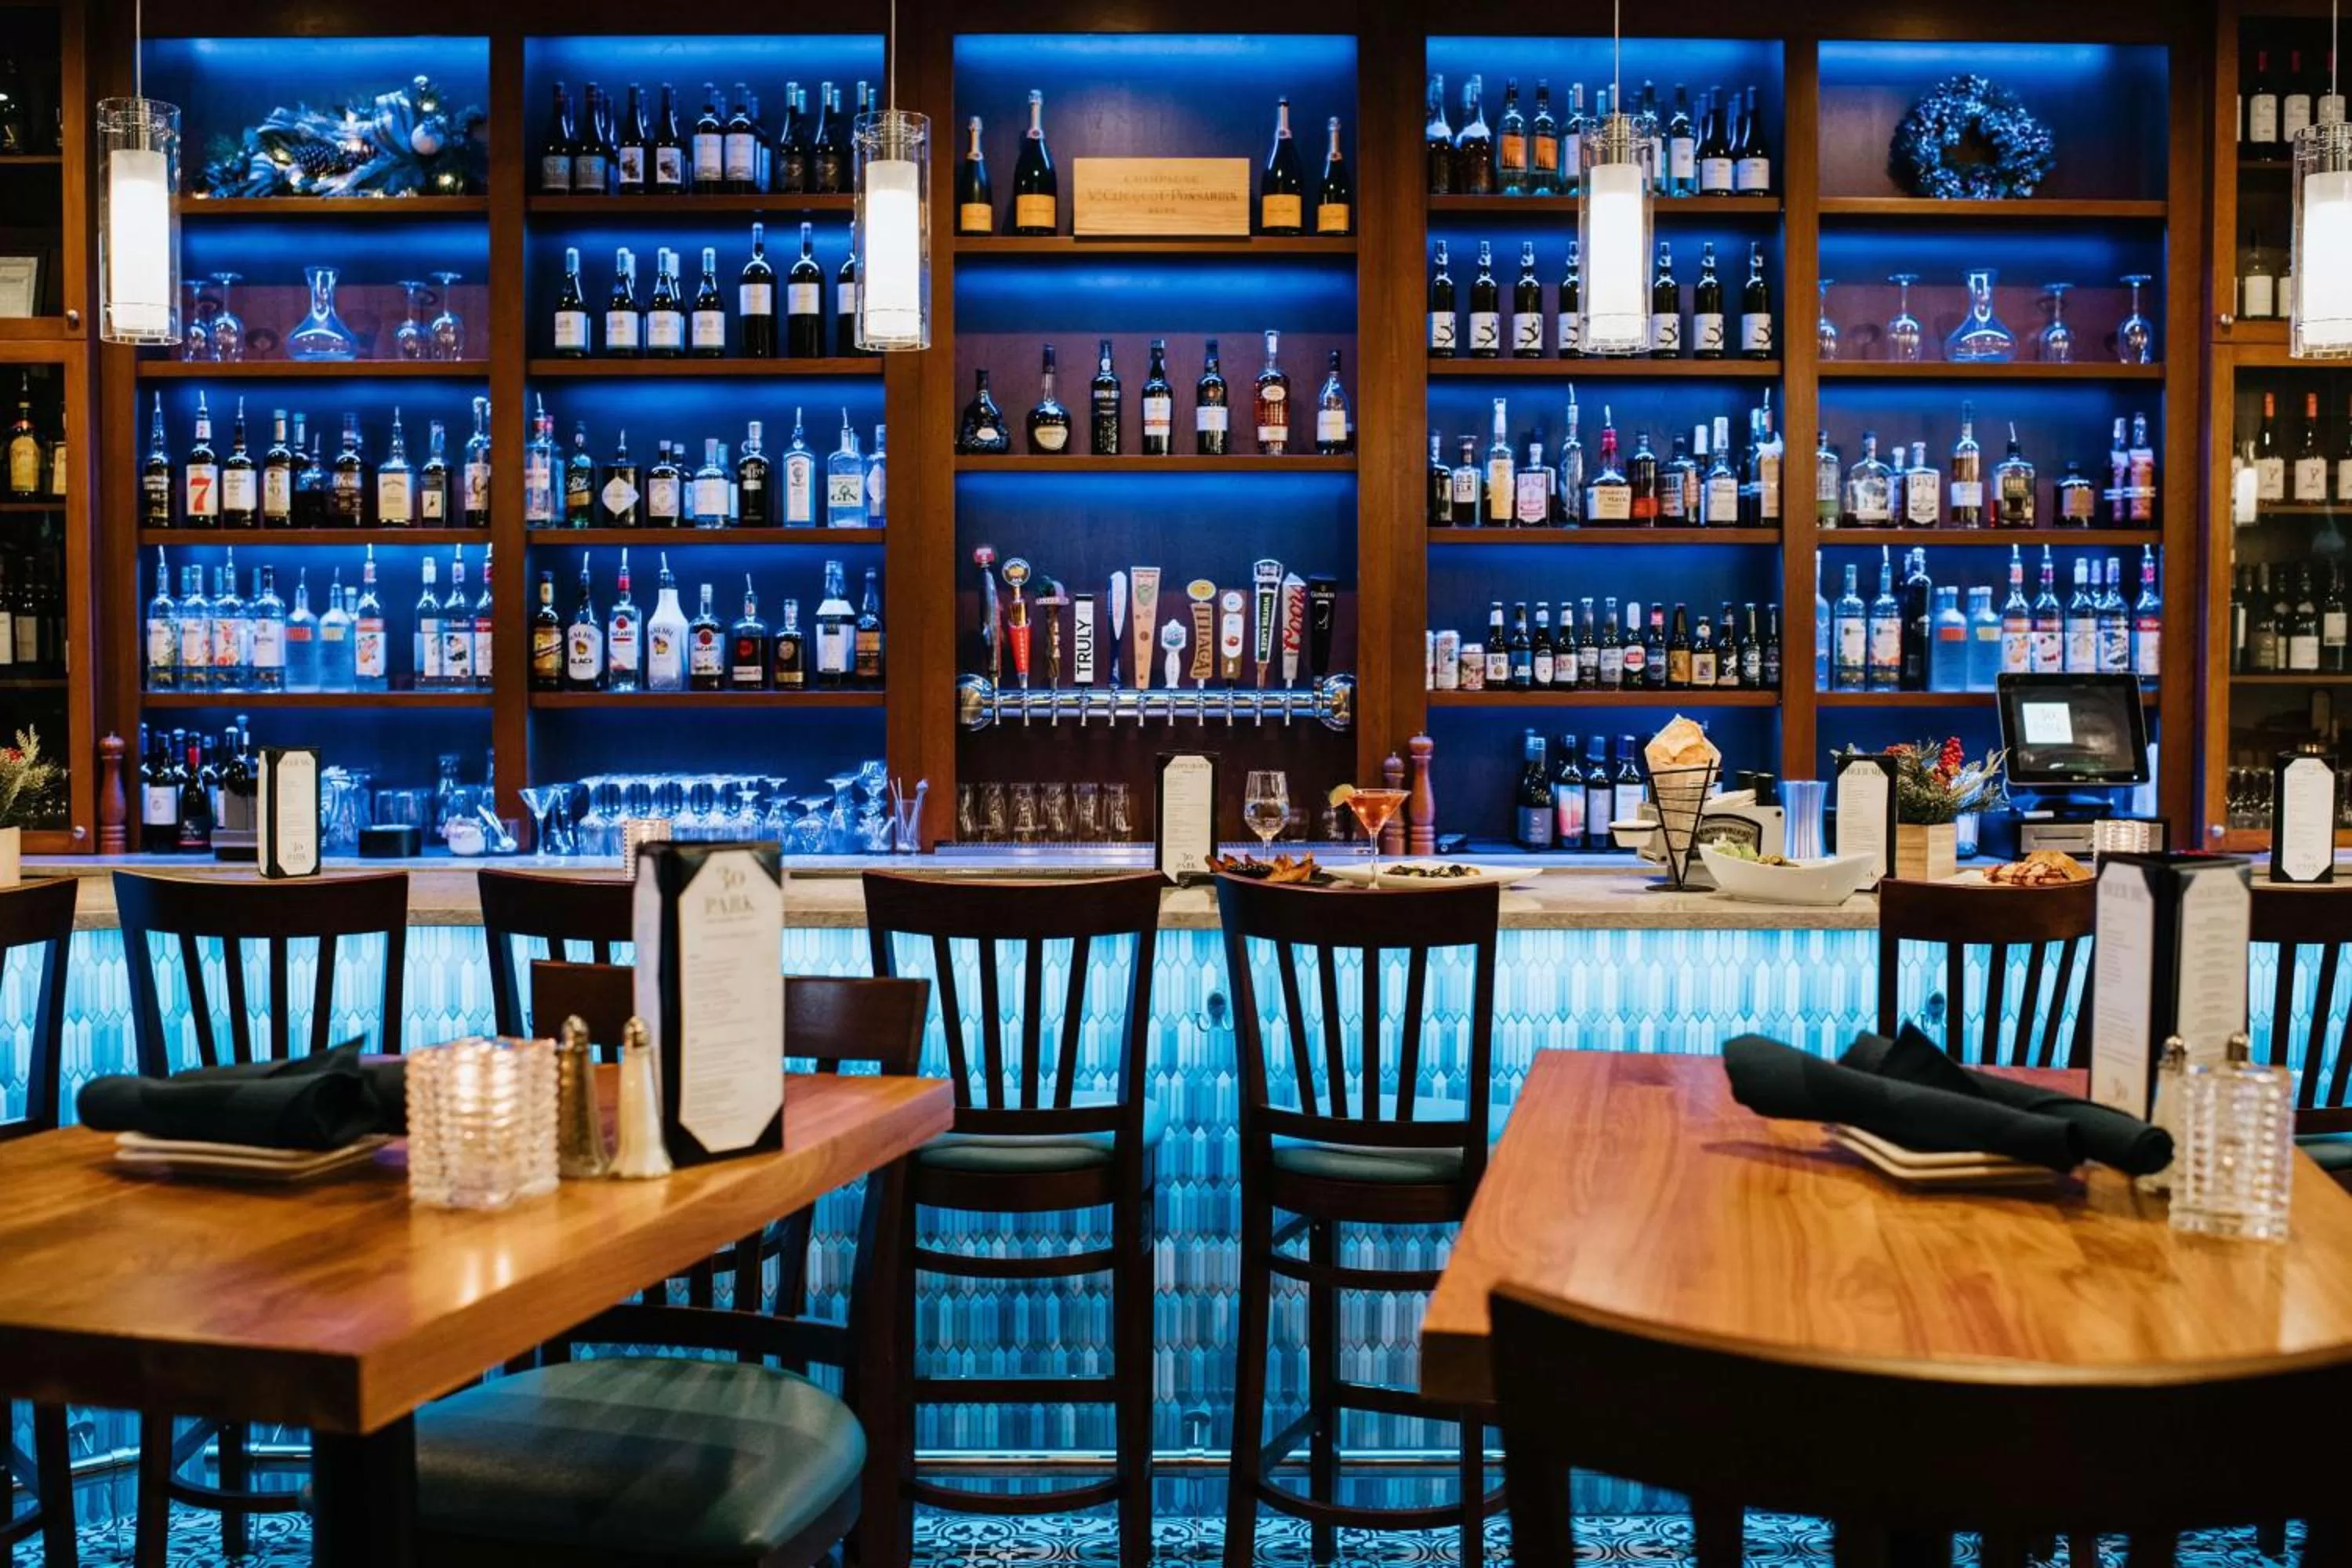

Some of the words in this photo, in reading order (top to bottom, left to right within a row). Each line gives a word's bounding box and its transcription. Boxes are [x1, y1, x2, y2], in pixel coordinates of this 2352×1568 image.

[1456, 475, 1472, 484] OLD
[1456, 485, 1472, 493] ELK
[190, 477, 212, 513] 7
[1077, 619, 1091, 674] TRULY
